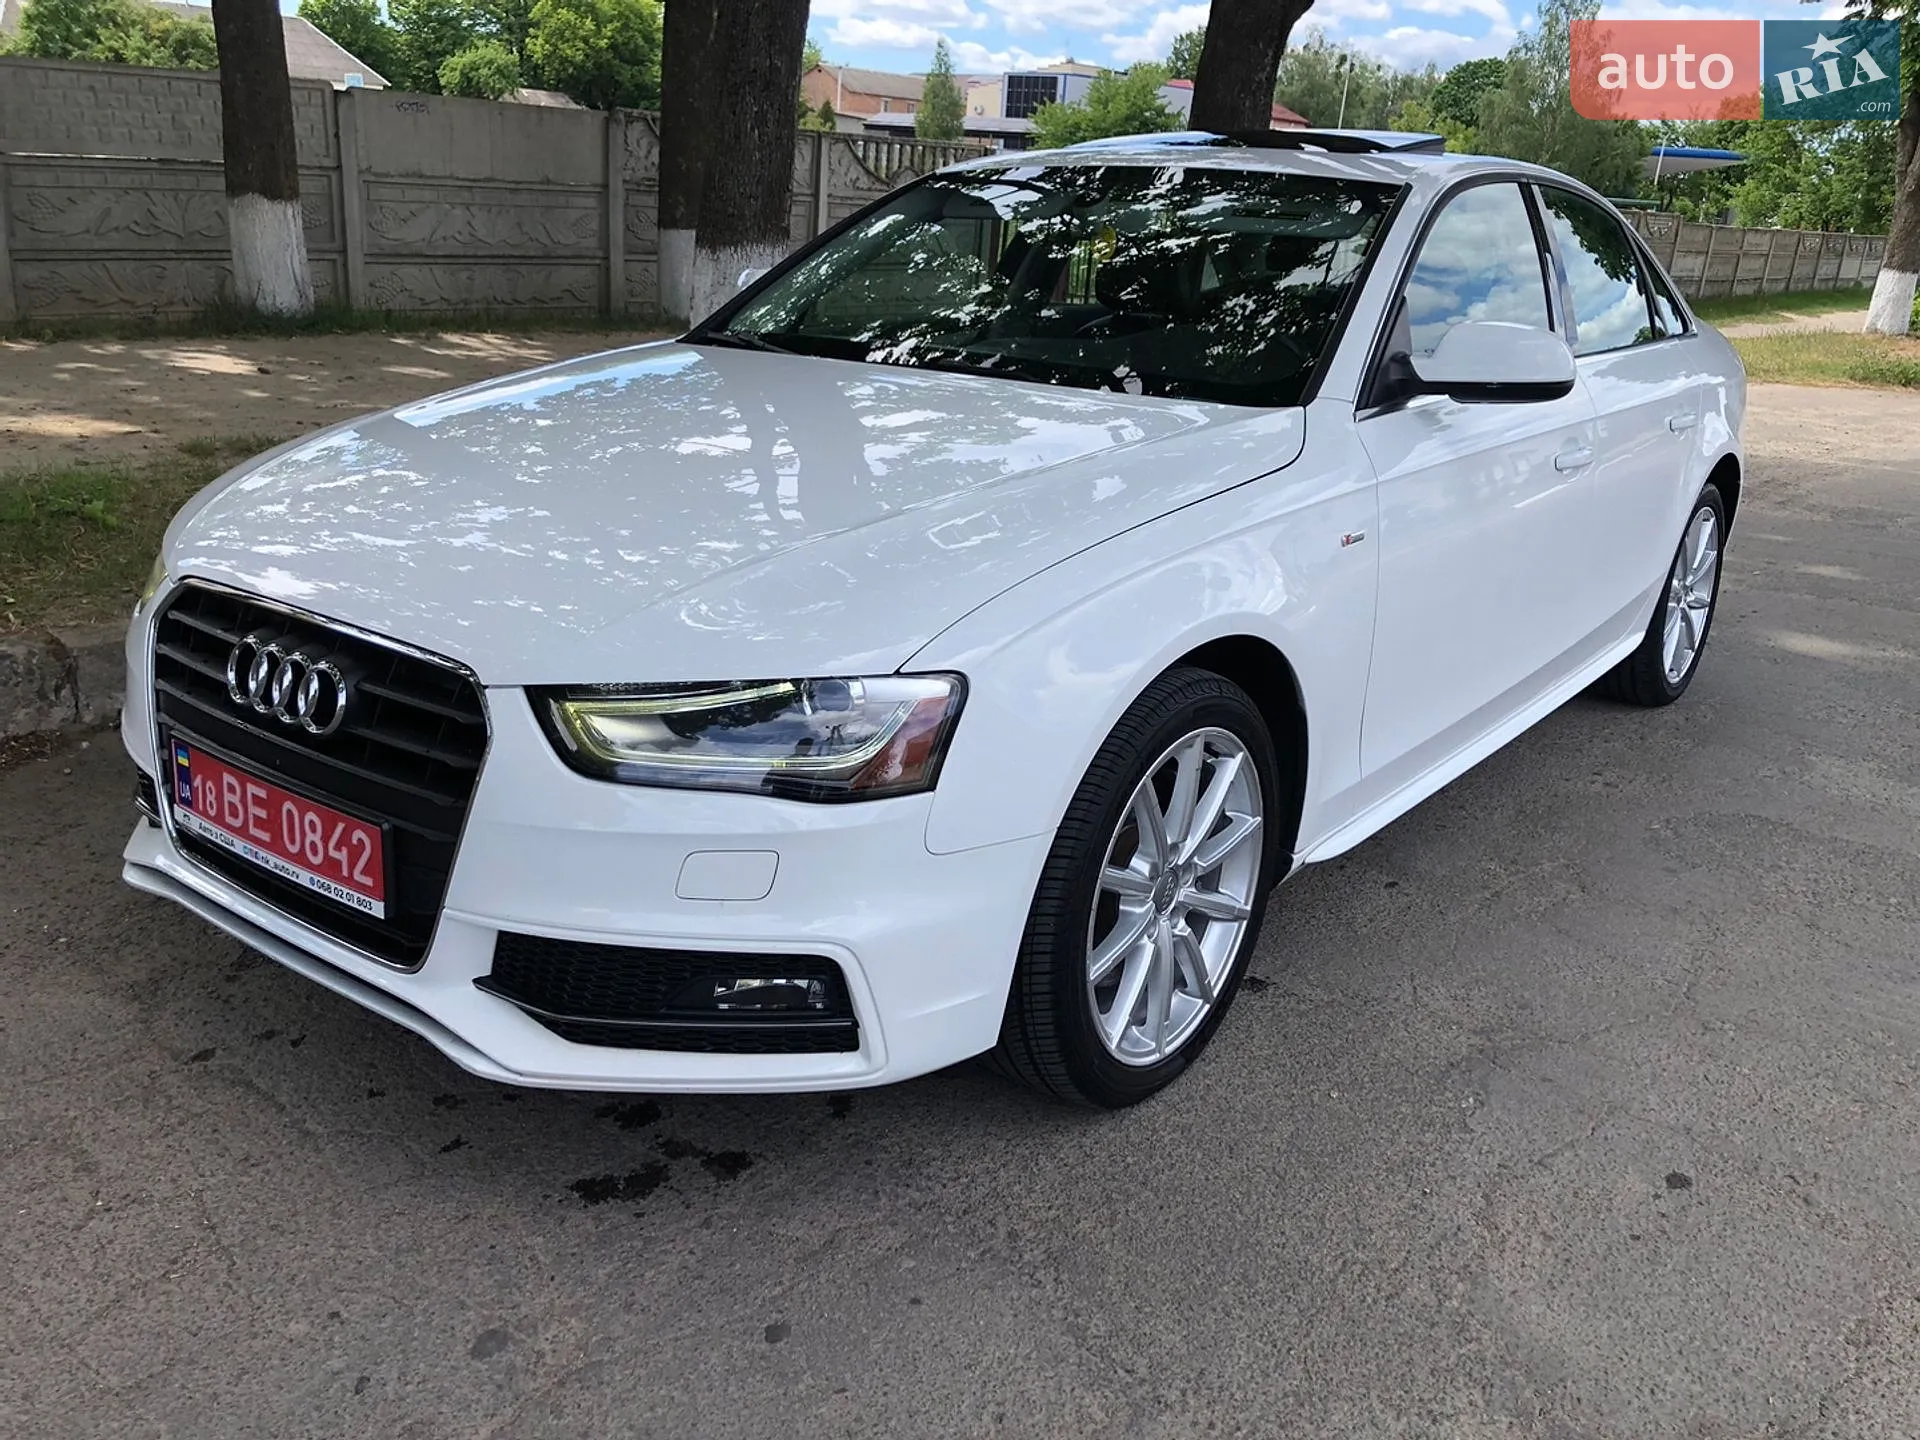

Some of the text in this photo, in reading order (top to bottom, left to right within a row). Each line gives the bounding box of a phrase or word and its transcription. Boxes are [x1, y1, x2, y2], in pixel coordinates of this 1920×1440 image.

[179, 782, 192, 801] UA
[193, 771, 374, 888] 18 BE 0842
[219, 832, 236, 849] США
[316, 879, 373, 911] 068 02 01 803
